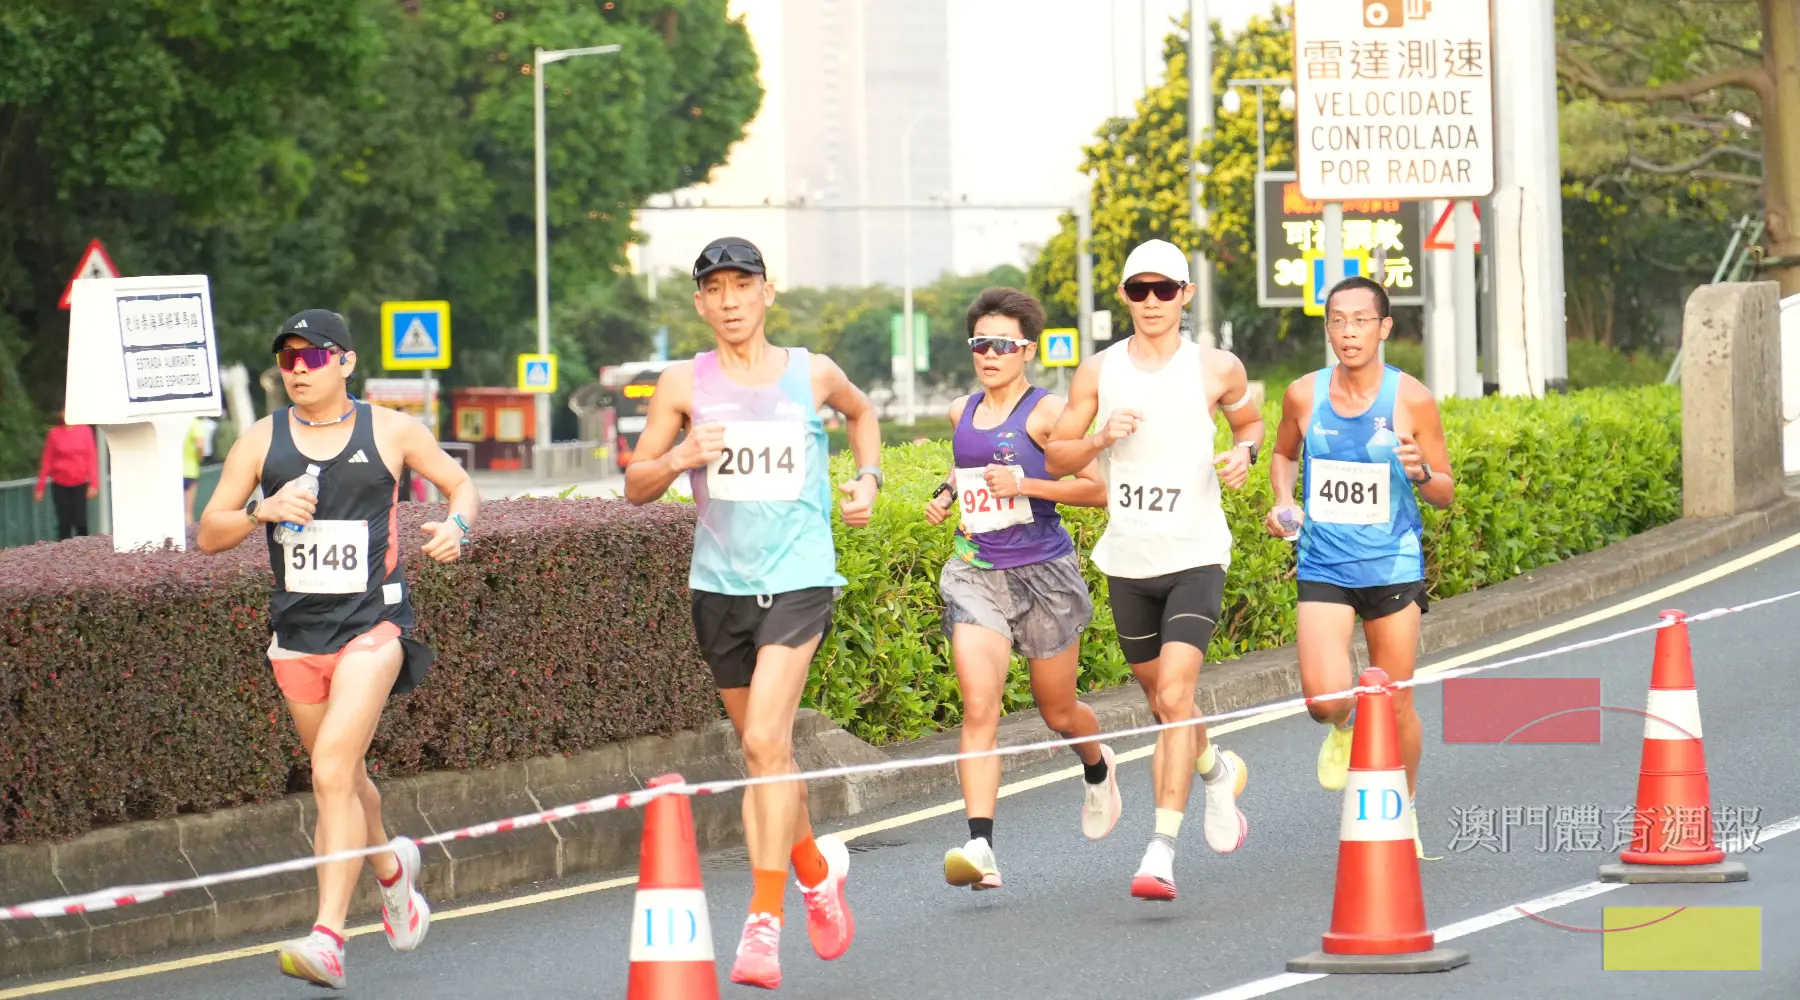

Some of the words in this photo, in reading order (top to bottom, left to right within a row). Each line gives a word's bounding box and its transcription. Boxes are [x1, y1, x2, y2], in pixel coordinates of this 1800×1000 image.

[1304, 39, 1483, 79] 雷達測速
[1315, 91, 1473, 116] VELOCIDADE
[1312, 125, 1479, 151] CONTROLADA
[1321, 160, 1370, 184] POR
[1388, 159, 1471, 183] RADAR
[136, 357, 162, 370] ESTRADA
[165, 354, 196, 368] ALMIRANTE
[718, 446, 795, 475] 2014
[1119, 483, 1182, 512] 3127
[1319, 480, 1379, 505] 4081
[291, 543, 358, 571] 5148
[1356, 789, 1403, 821] ID
[644, 908, 697, 947] ID
